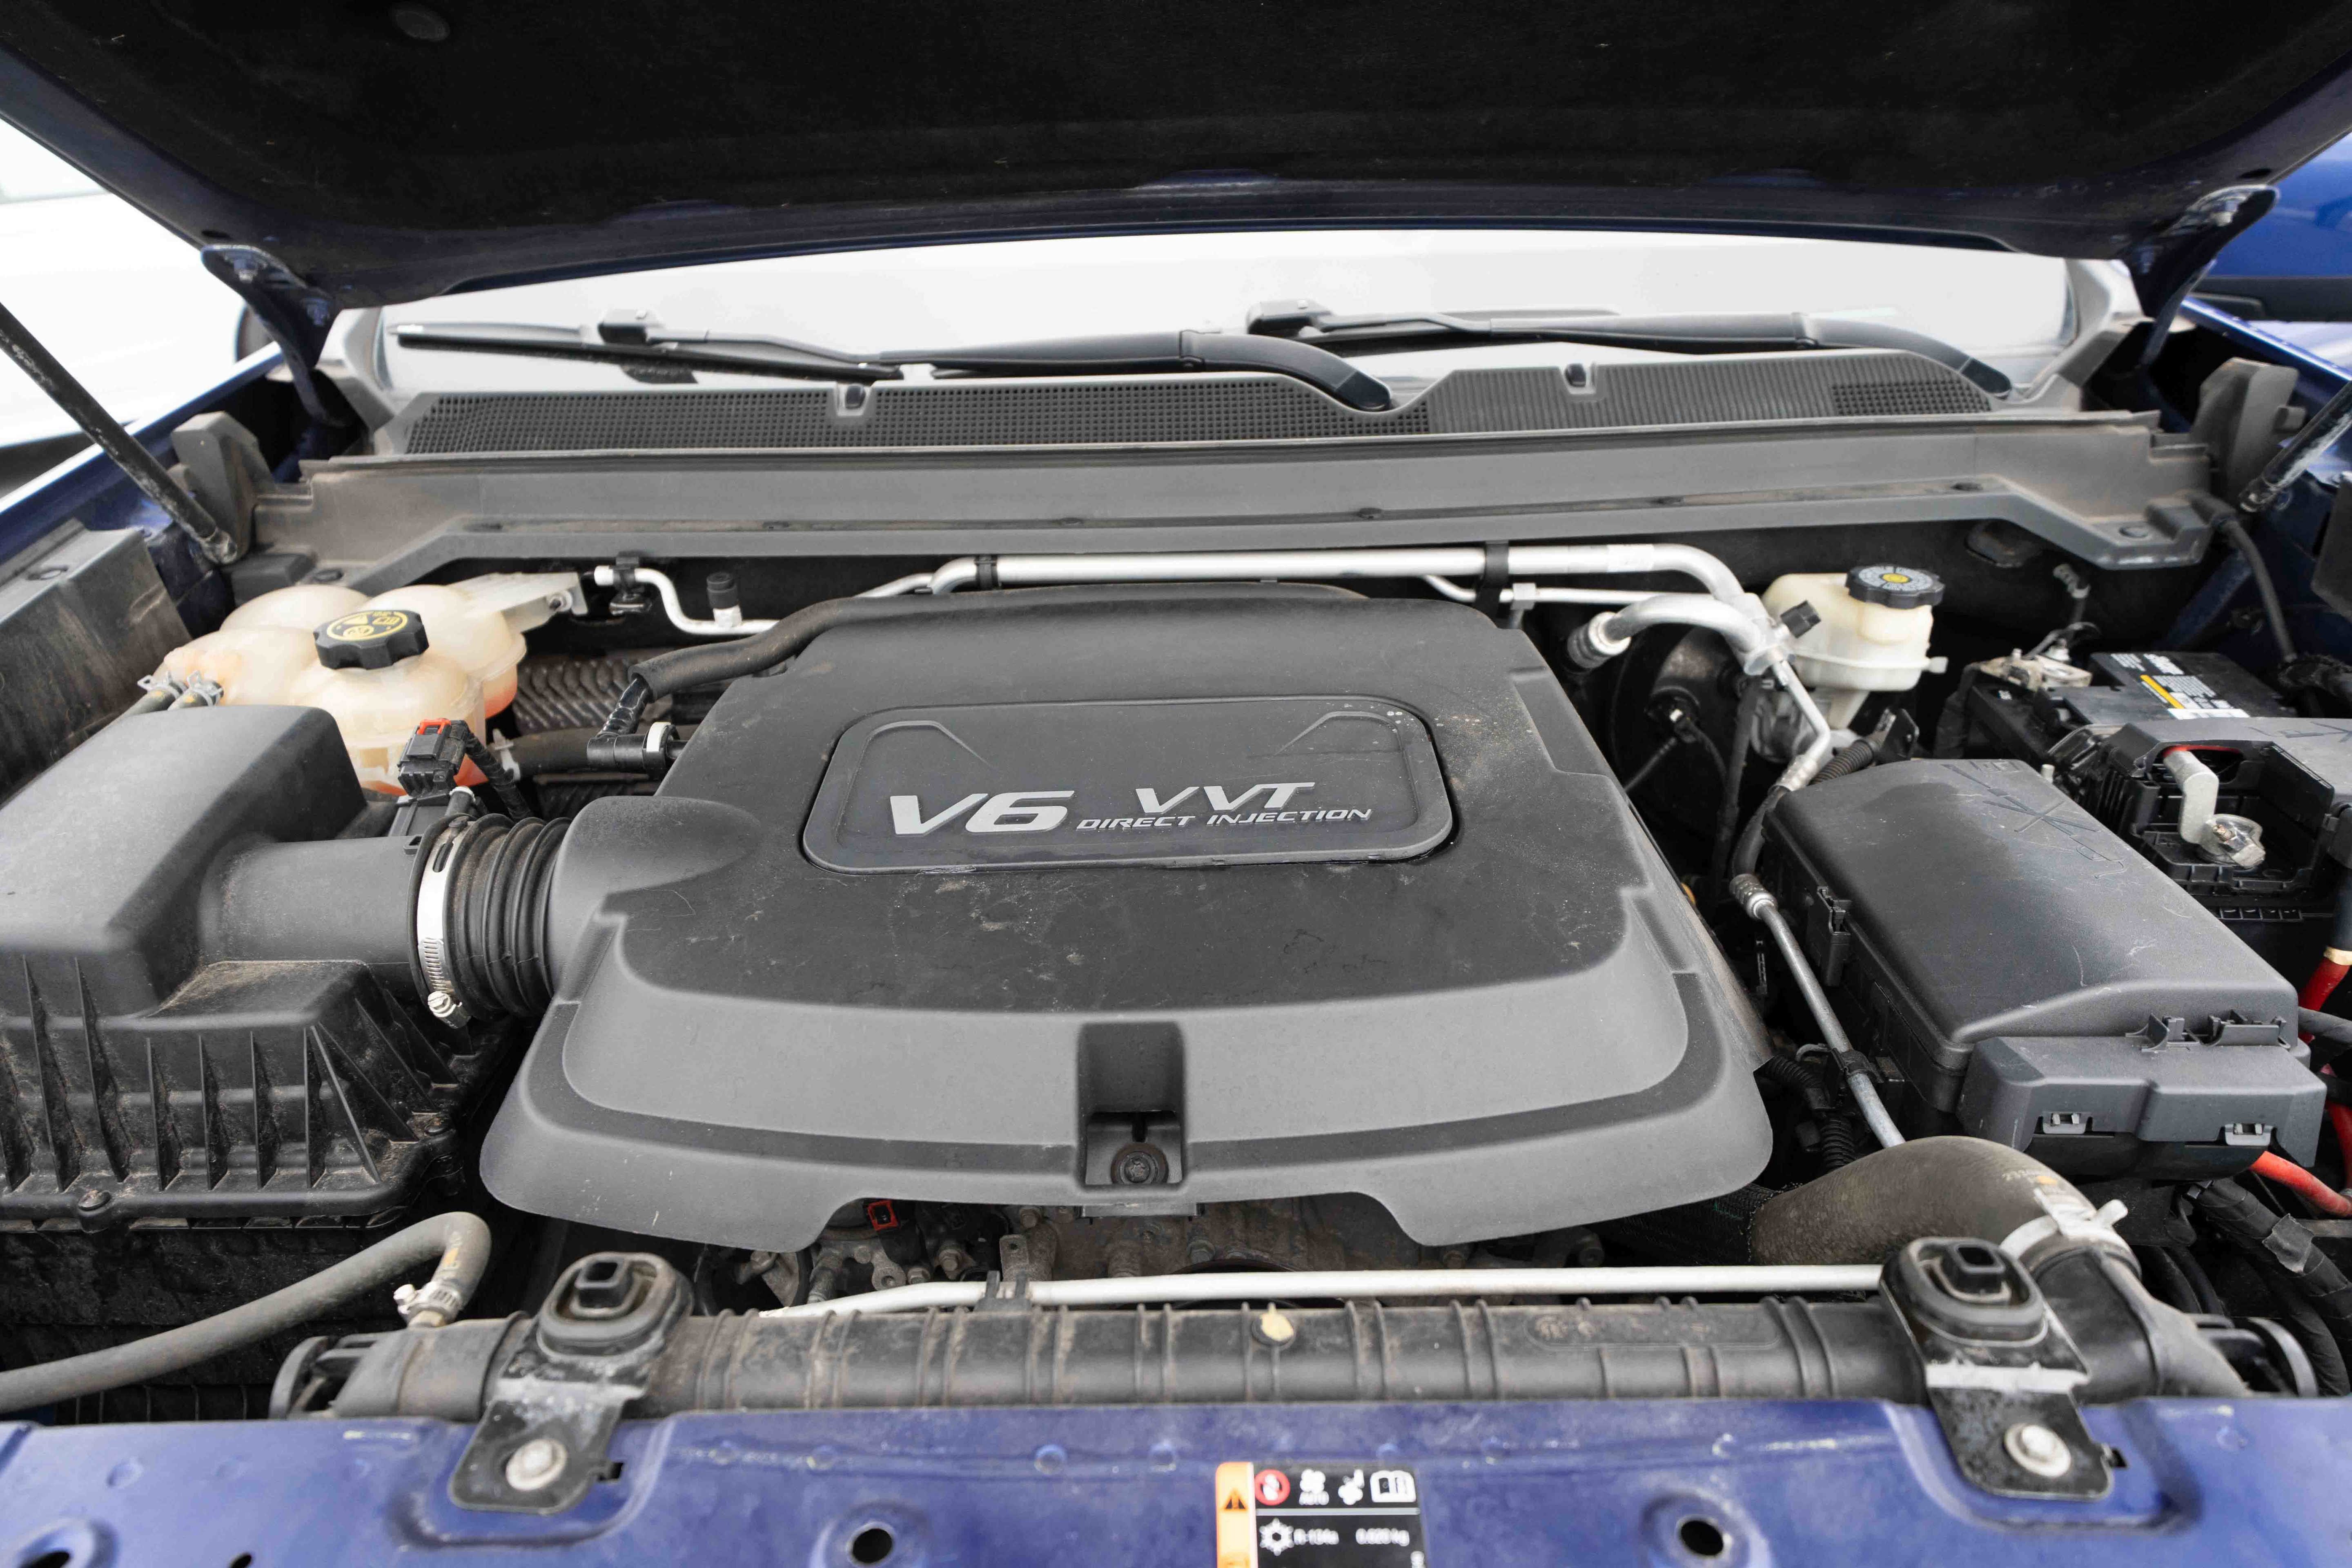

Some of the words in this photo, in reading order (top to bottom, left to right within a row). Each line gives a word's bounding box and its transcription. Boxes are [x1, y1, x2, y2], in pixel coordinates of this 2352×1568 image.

[890, 791, 1075, 835] V6
[1136, 782, 1315, 813] VVT
[1076, 816, 1196, 831] DIRECT
[1207, 809, 1372, 825] INJECTION
